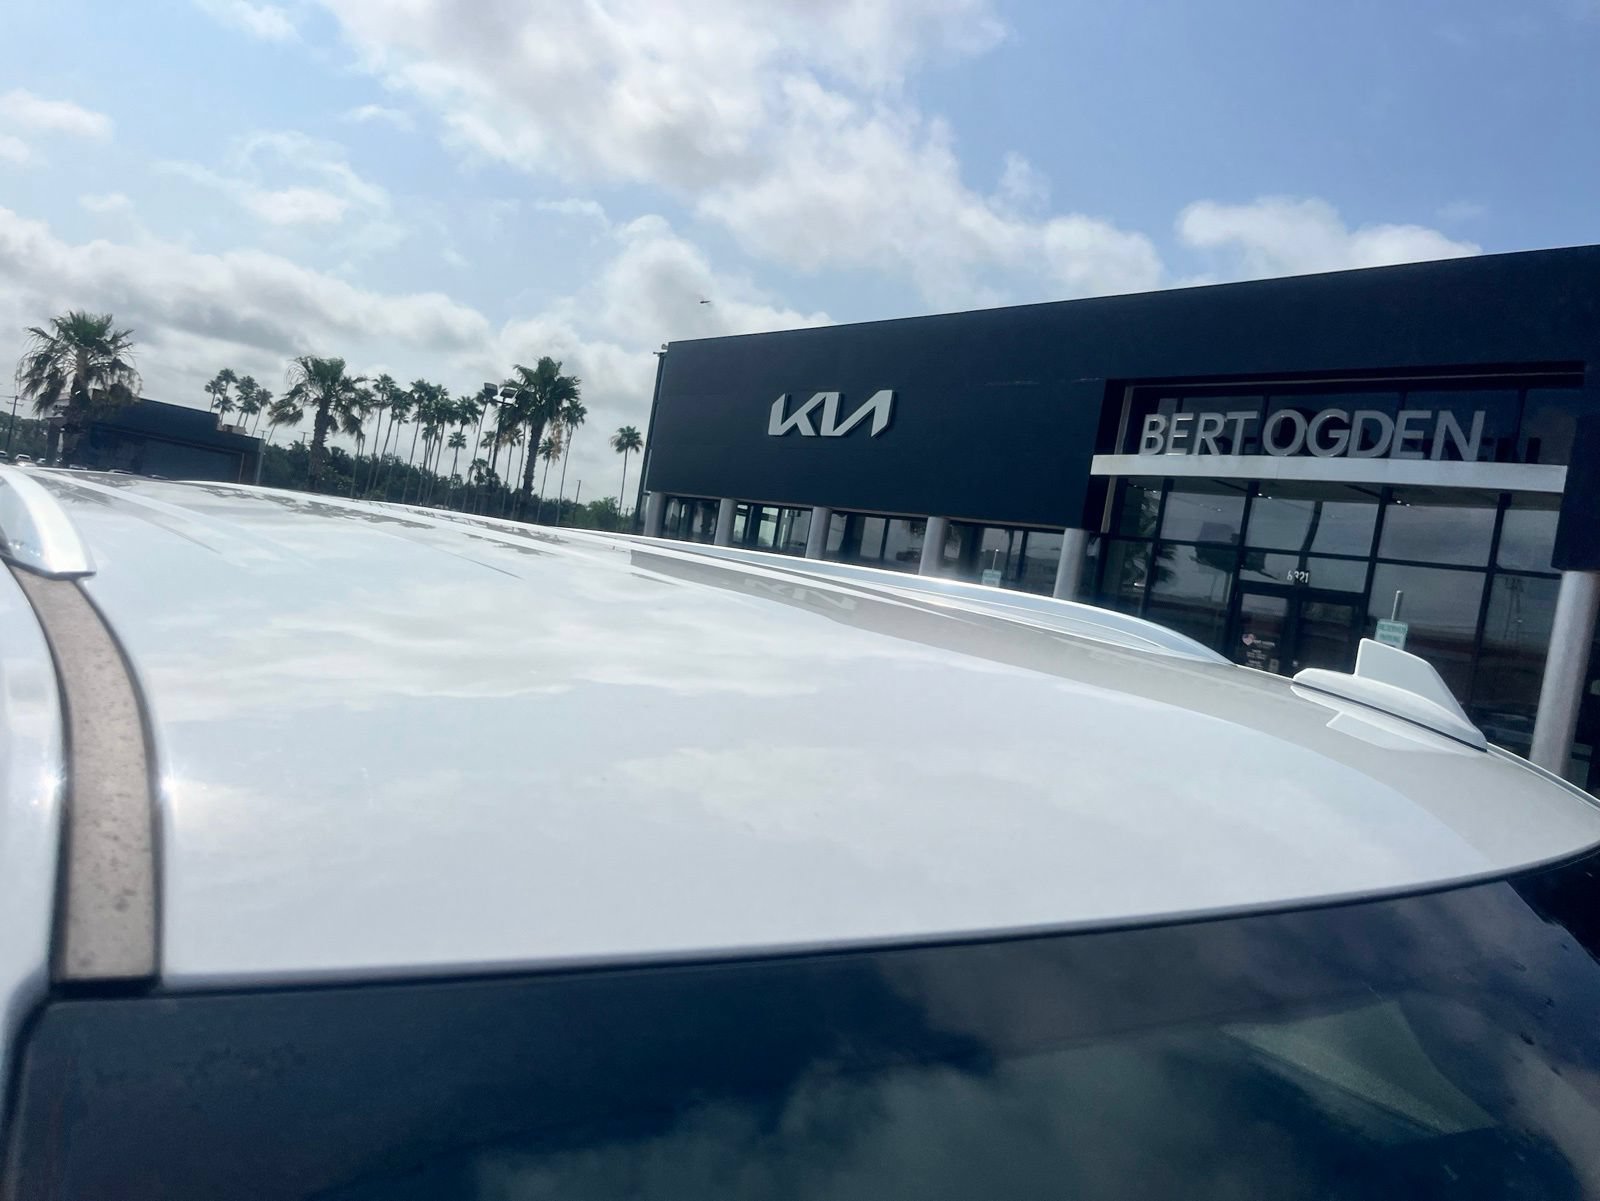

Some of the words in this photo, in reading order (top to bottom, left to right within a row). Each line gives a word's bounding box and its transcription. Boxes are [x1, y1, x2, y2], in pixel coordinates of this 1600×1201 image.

[768, 389, 894, 437] KIA
[1138, 410, 1258, 456] BERT
[1262, 408, 1486, 461] OGDEN
